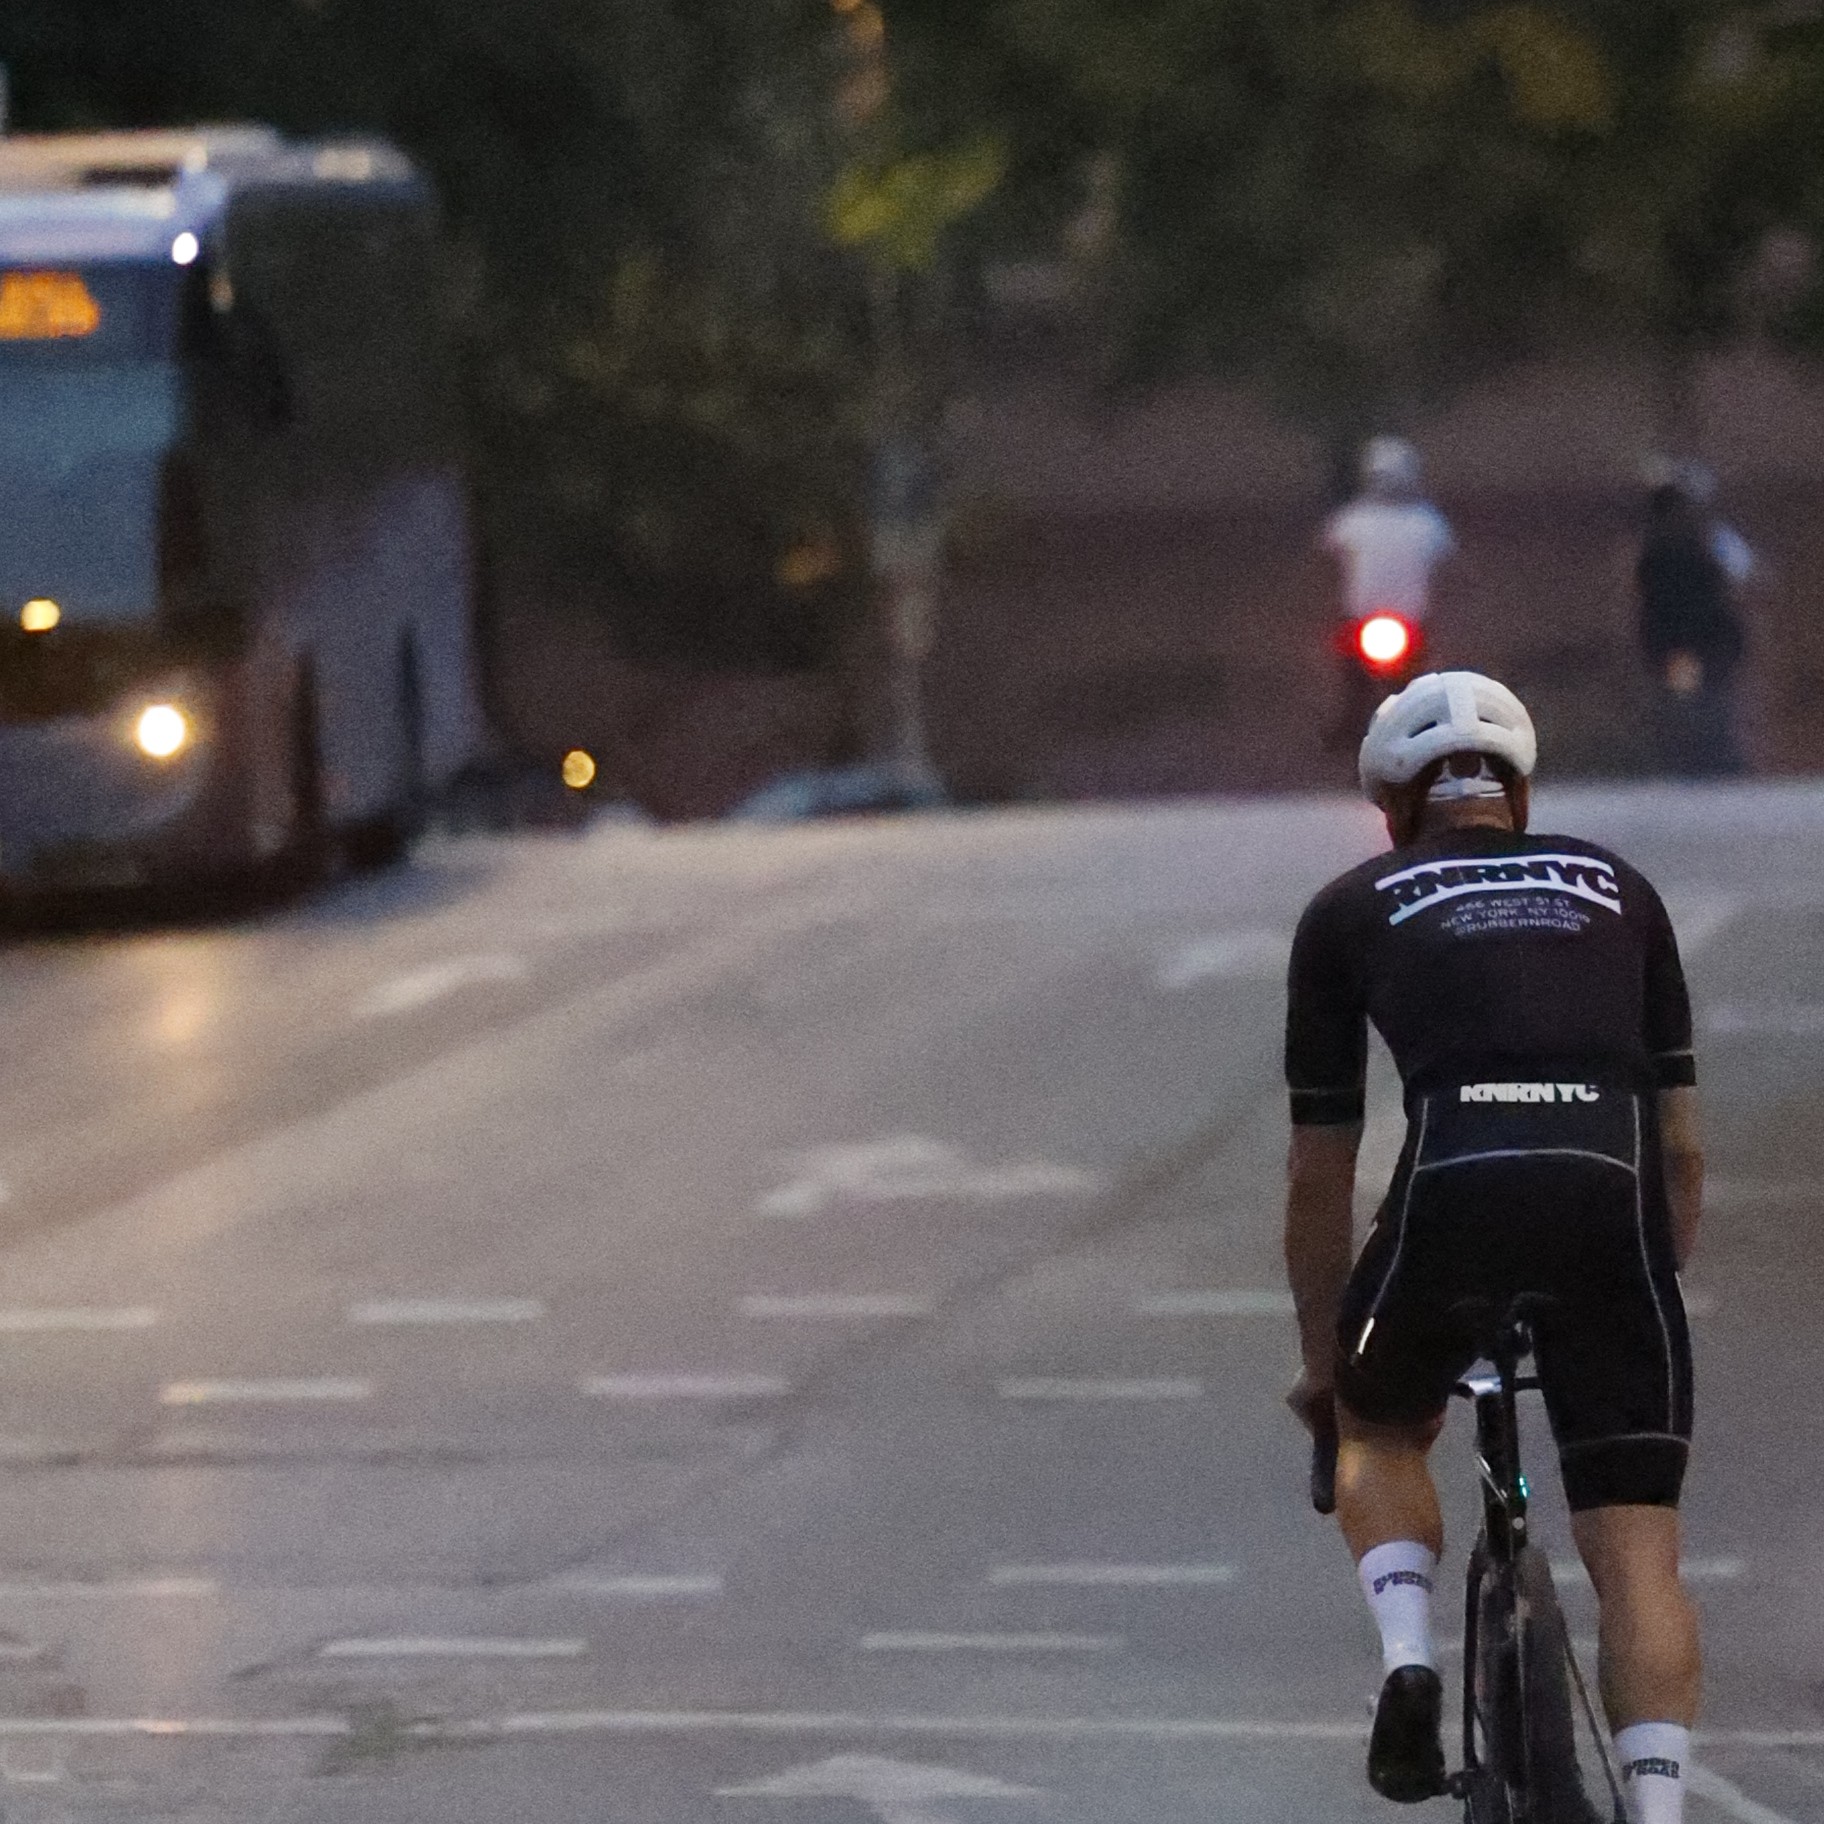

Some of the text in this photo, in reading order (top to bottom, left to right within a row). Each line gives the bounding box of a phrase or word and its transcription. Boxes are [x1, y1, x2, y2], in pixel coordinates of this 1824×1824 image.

[1490, 897, 1529, 908] WEST
[1553, 898, 1571, 908] ST
[1440, 913, 1473, 929] NEW
[1527, 907, 1549, 917] NY
